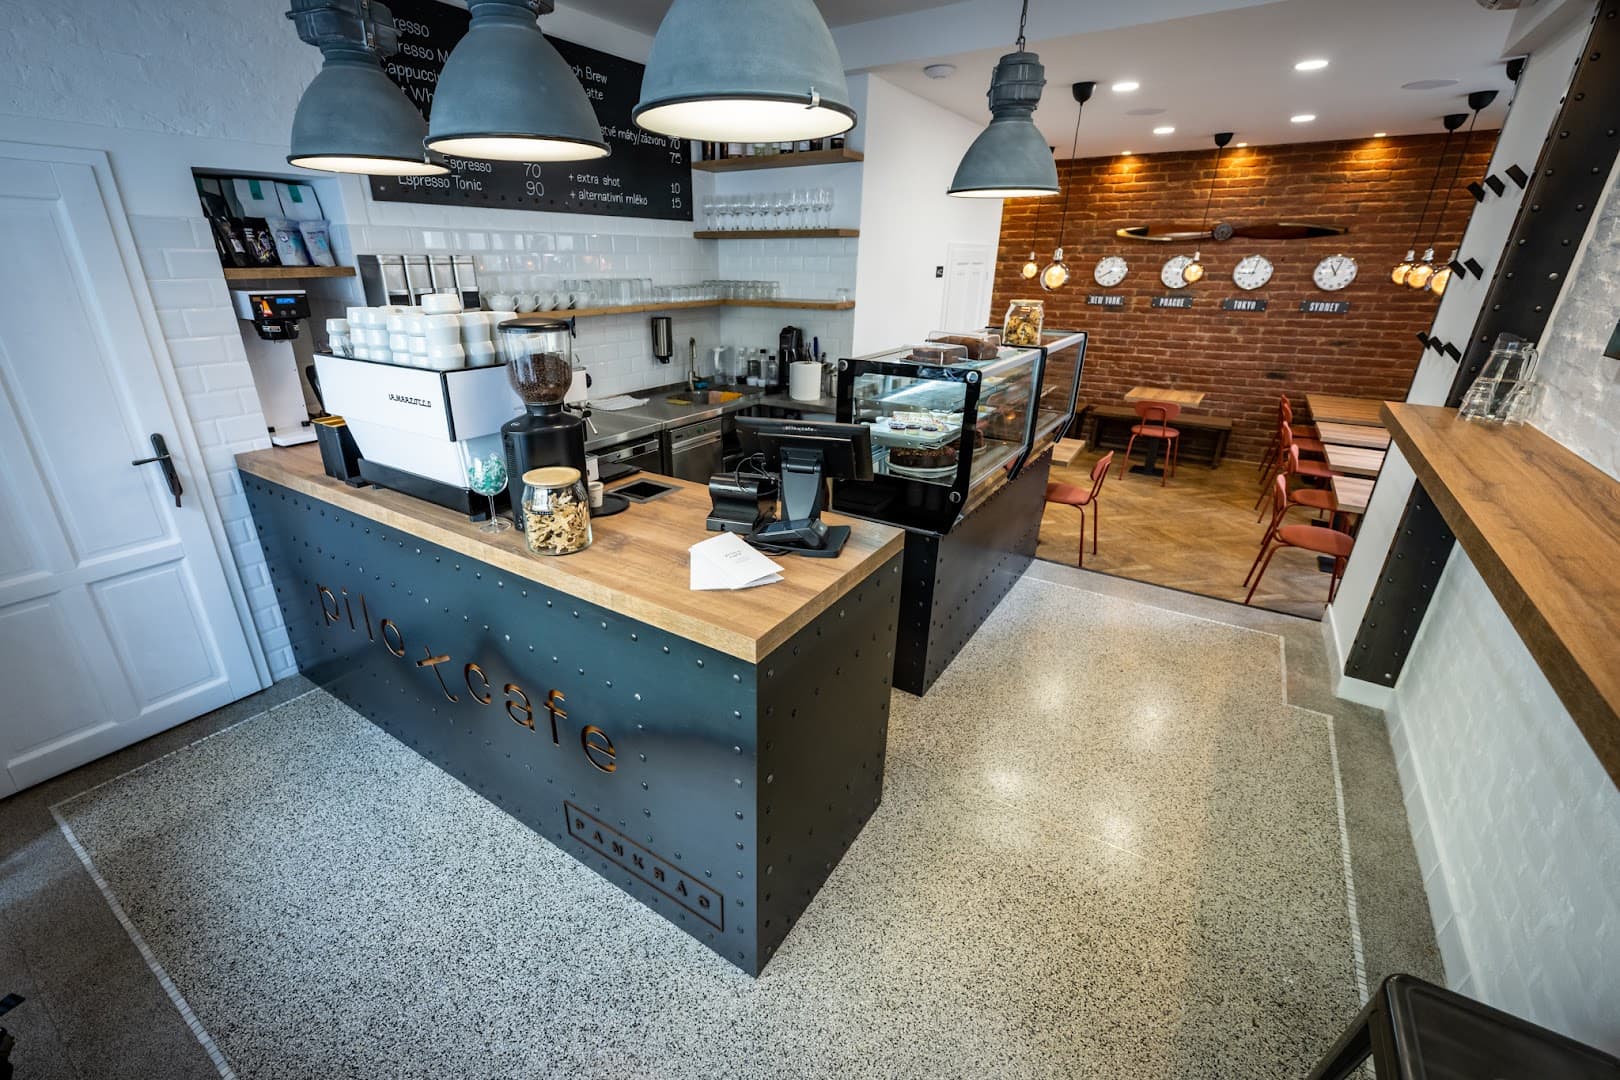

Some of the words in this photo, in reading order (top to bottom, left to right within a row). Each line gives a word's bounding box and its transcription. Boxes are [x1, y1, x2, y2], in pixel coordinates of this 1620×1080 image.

[523, 163, 542, 178] 70
[451, 174, 482, 191] Tonic
[526, 180, 545, 197] 90
[576, 174, 599, 184] extra
[602, 175, 621, 188] shot
[578, 189, 624, 203] alternativní
[671, 197, 682, 209] 15
[1159, 297, 1185, 307] PRAGUE
[1233, 300, 1257, 310] TOKYO
[1309, 302, 1340, 312] SYDNEY
